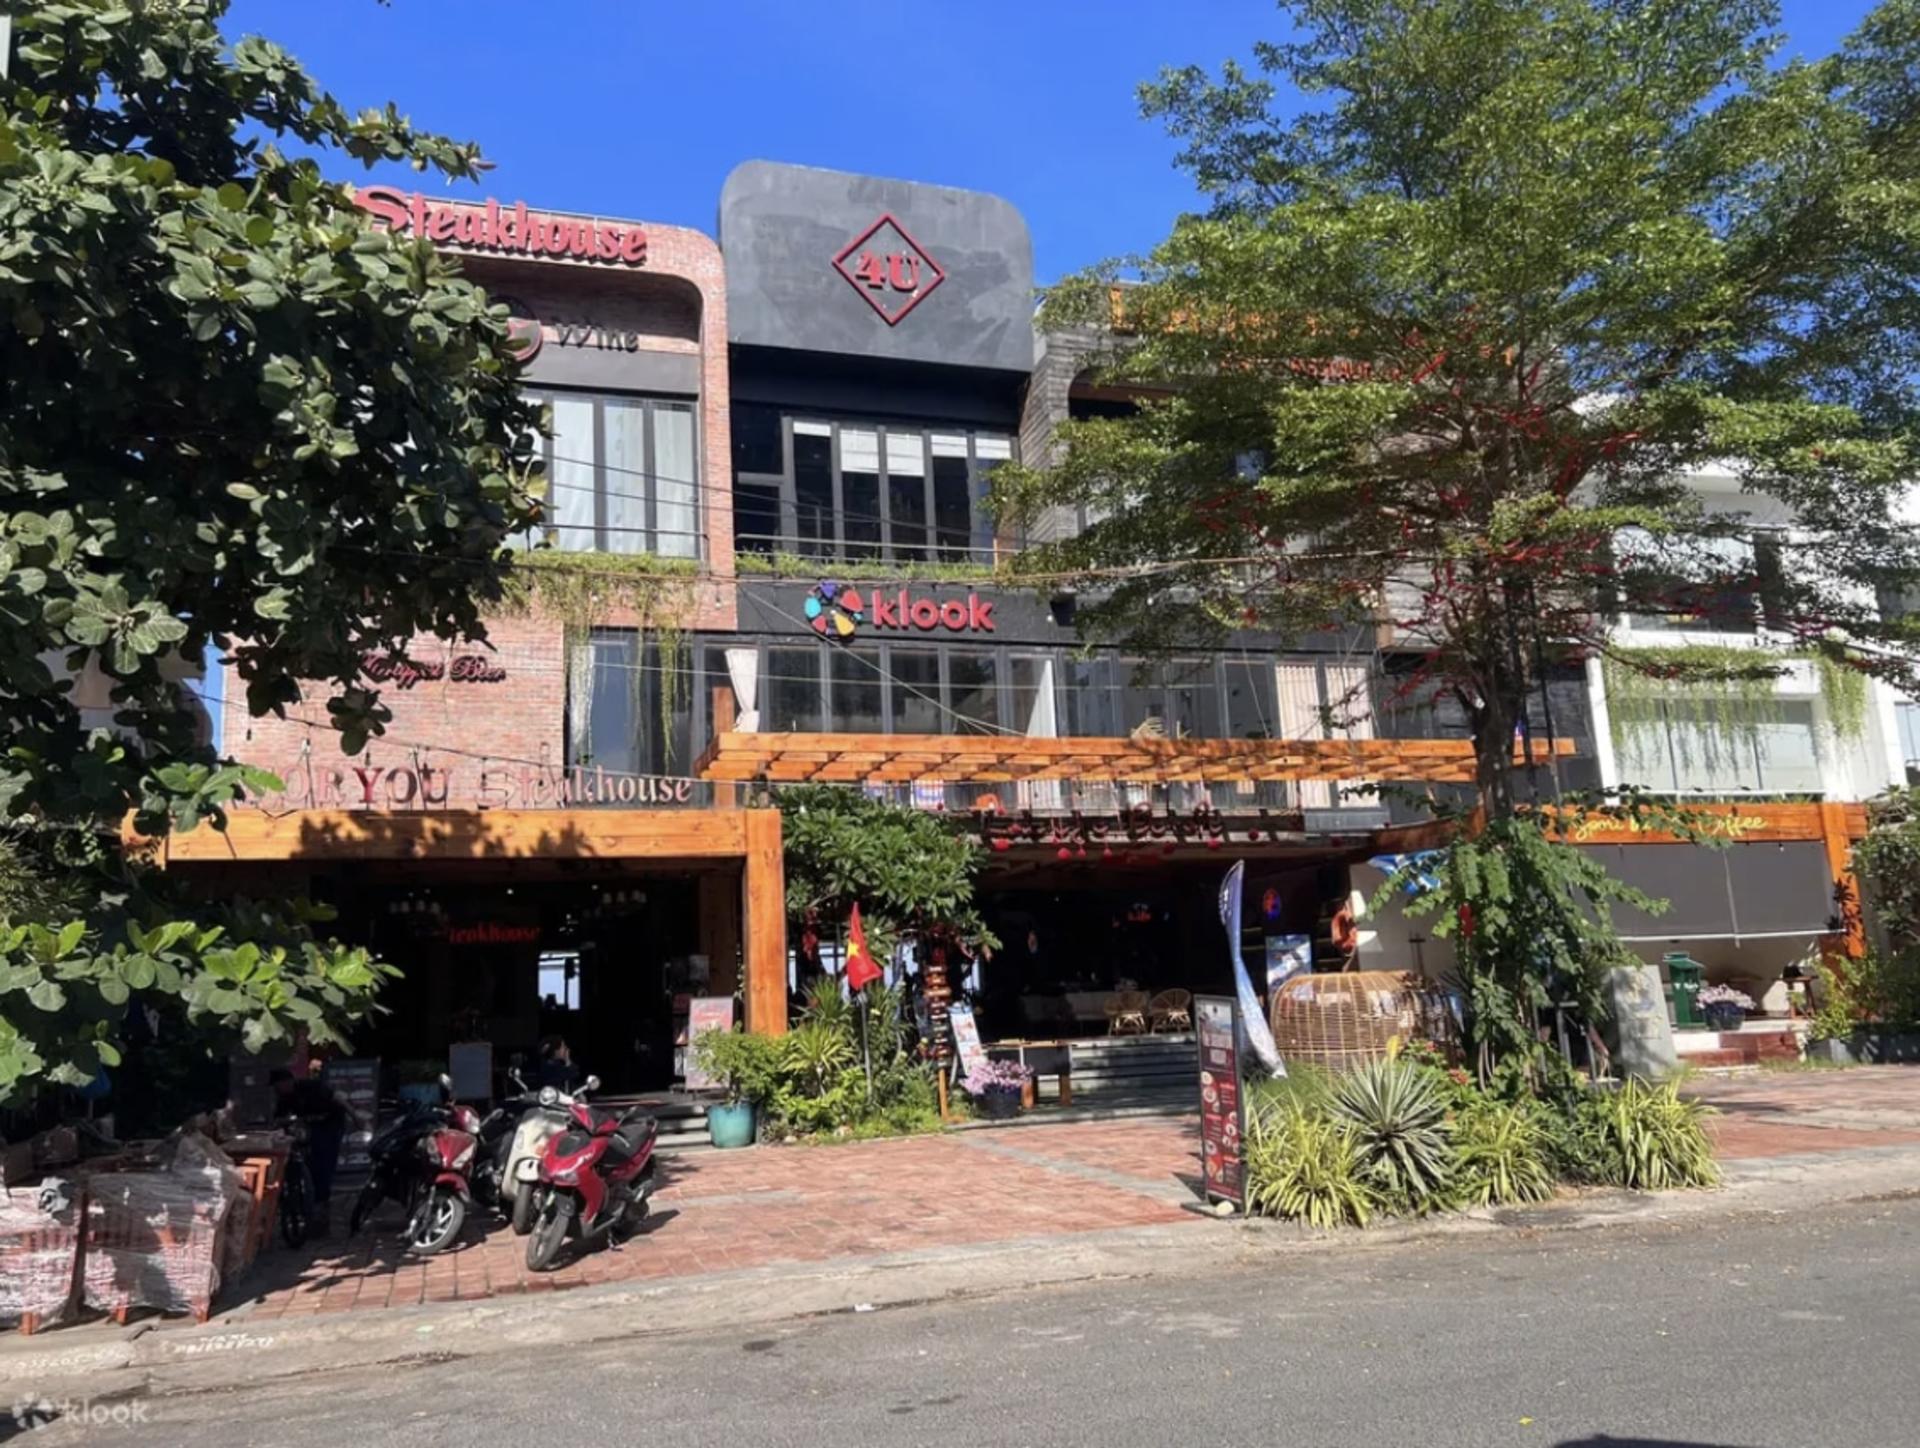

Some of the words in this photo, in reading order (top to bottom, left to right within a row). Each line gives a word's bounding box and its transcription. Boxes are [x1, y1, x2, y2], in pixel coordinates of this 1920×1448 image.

[352, 184, 648, 264] Steakhouse
[855, 251, 921, 291] 4U
[549, 316, 640, 352] Wine
[871, 588, 996, 632] klook
[255, 766, 347, 804] OR
[476, 764, 692, 808] Steakhouse
